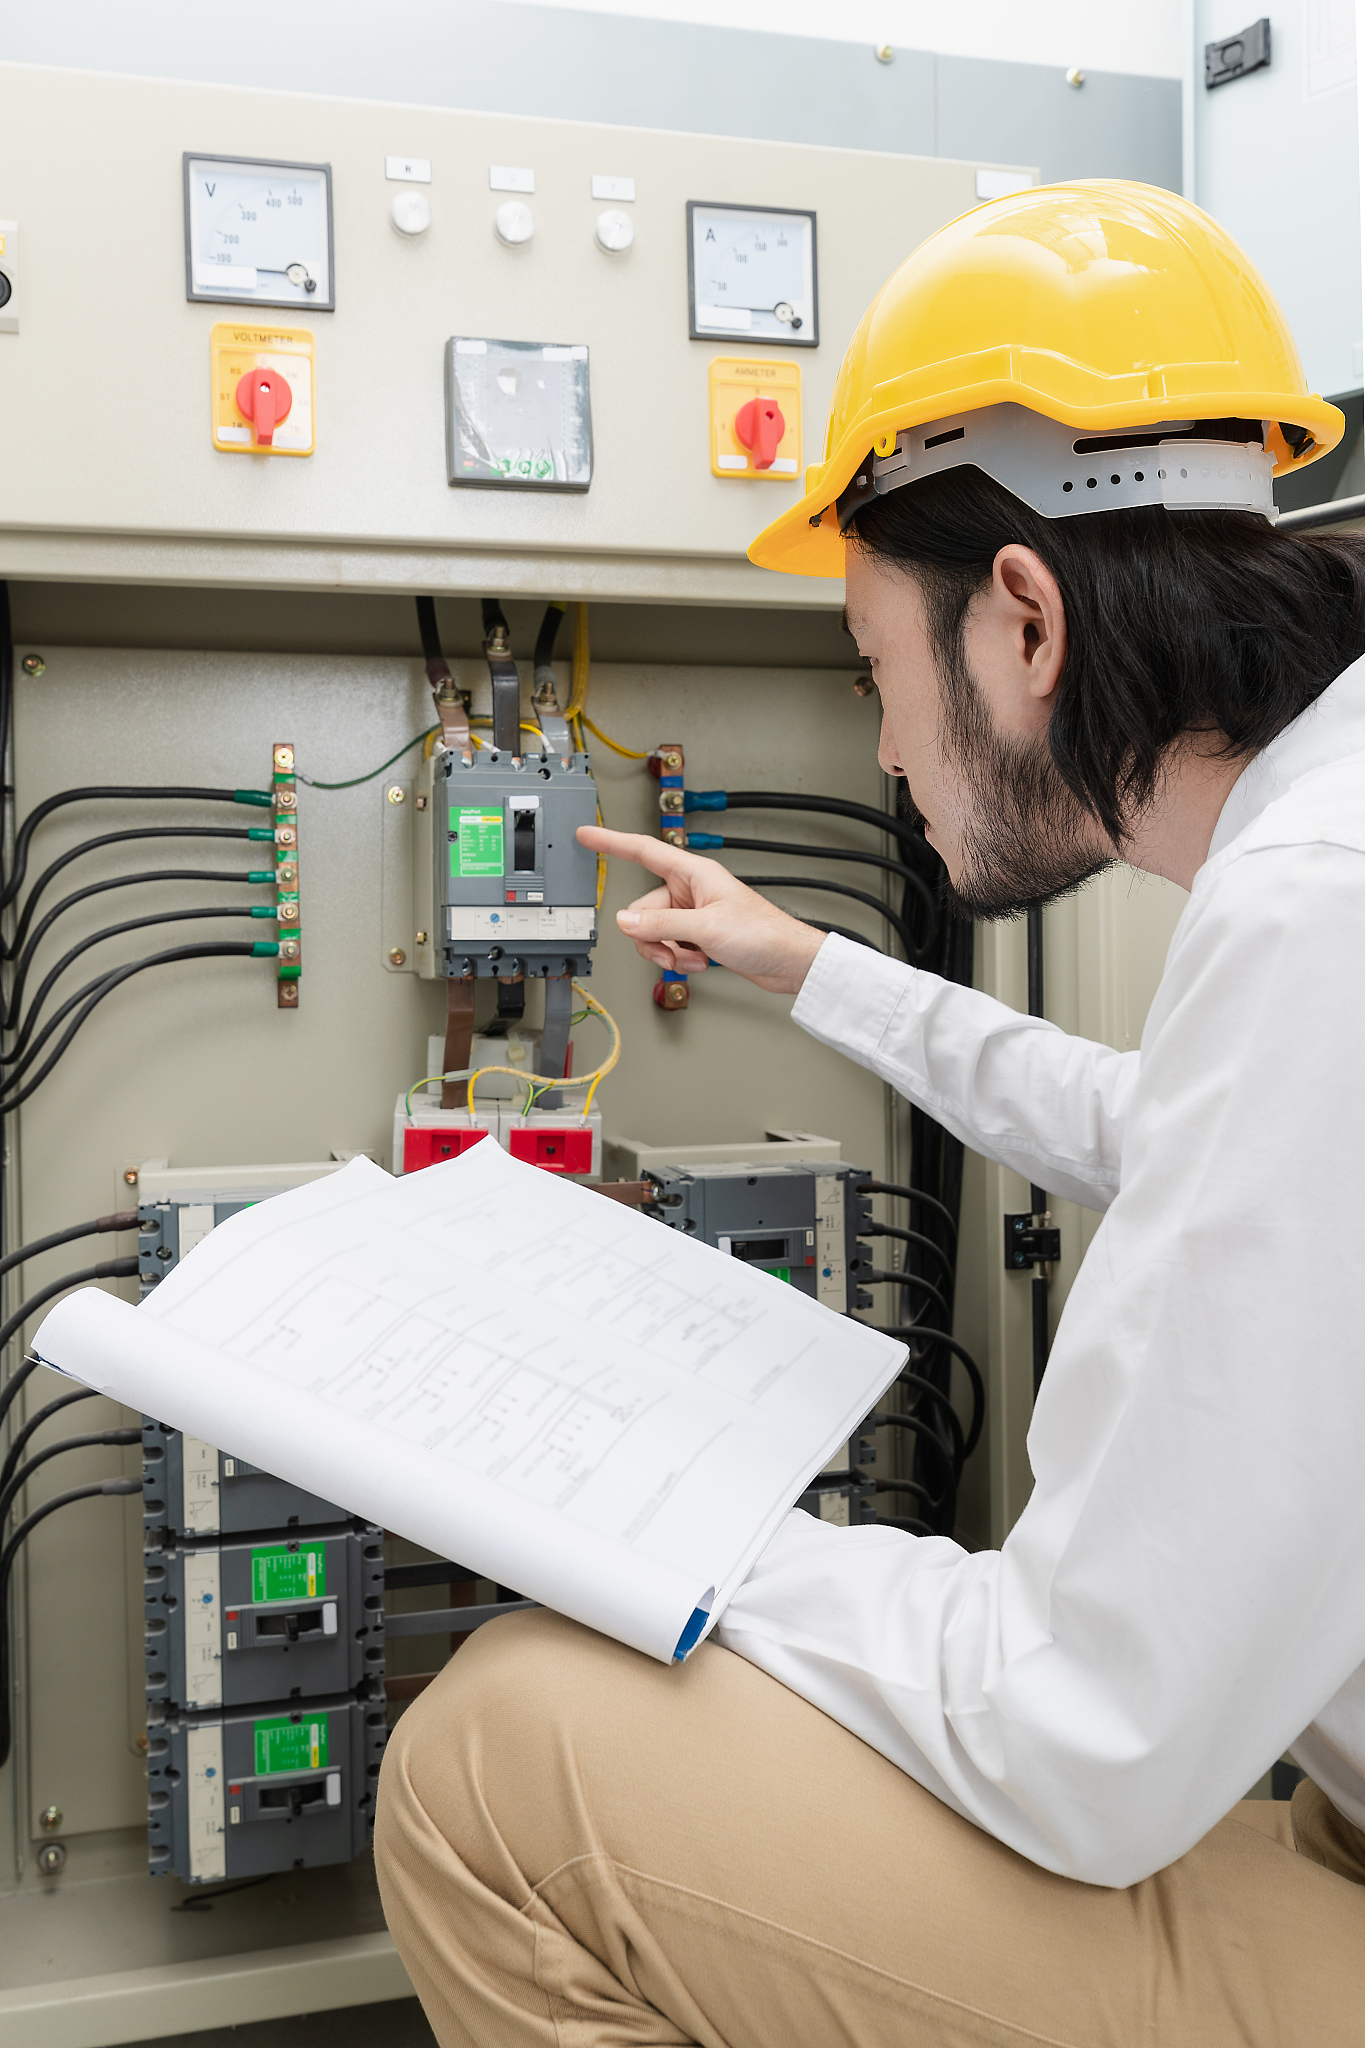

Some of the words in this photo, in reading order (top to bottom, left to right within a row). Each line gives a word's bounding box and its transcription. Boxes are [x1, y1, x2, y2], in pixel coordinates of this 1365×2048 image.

[205, 182, 216, 197] V
[266, 198, 282, 208] 400
[287, 195, 303, 206] 500
[241, 210, 257, 221] 300
[223, 234, 240, 245] 200
[706, 228, 716, 242] A
[754, 241, 767, 252] 150
[216, 252, 232, 263] 100
[718, 282, 727, 291] 50
[233, 331, 294, 344] VOLTMETER
[735, 367, 776, 378] AMMETER
